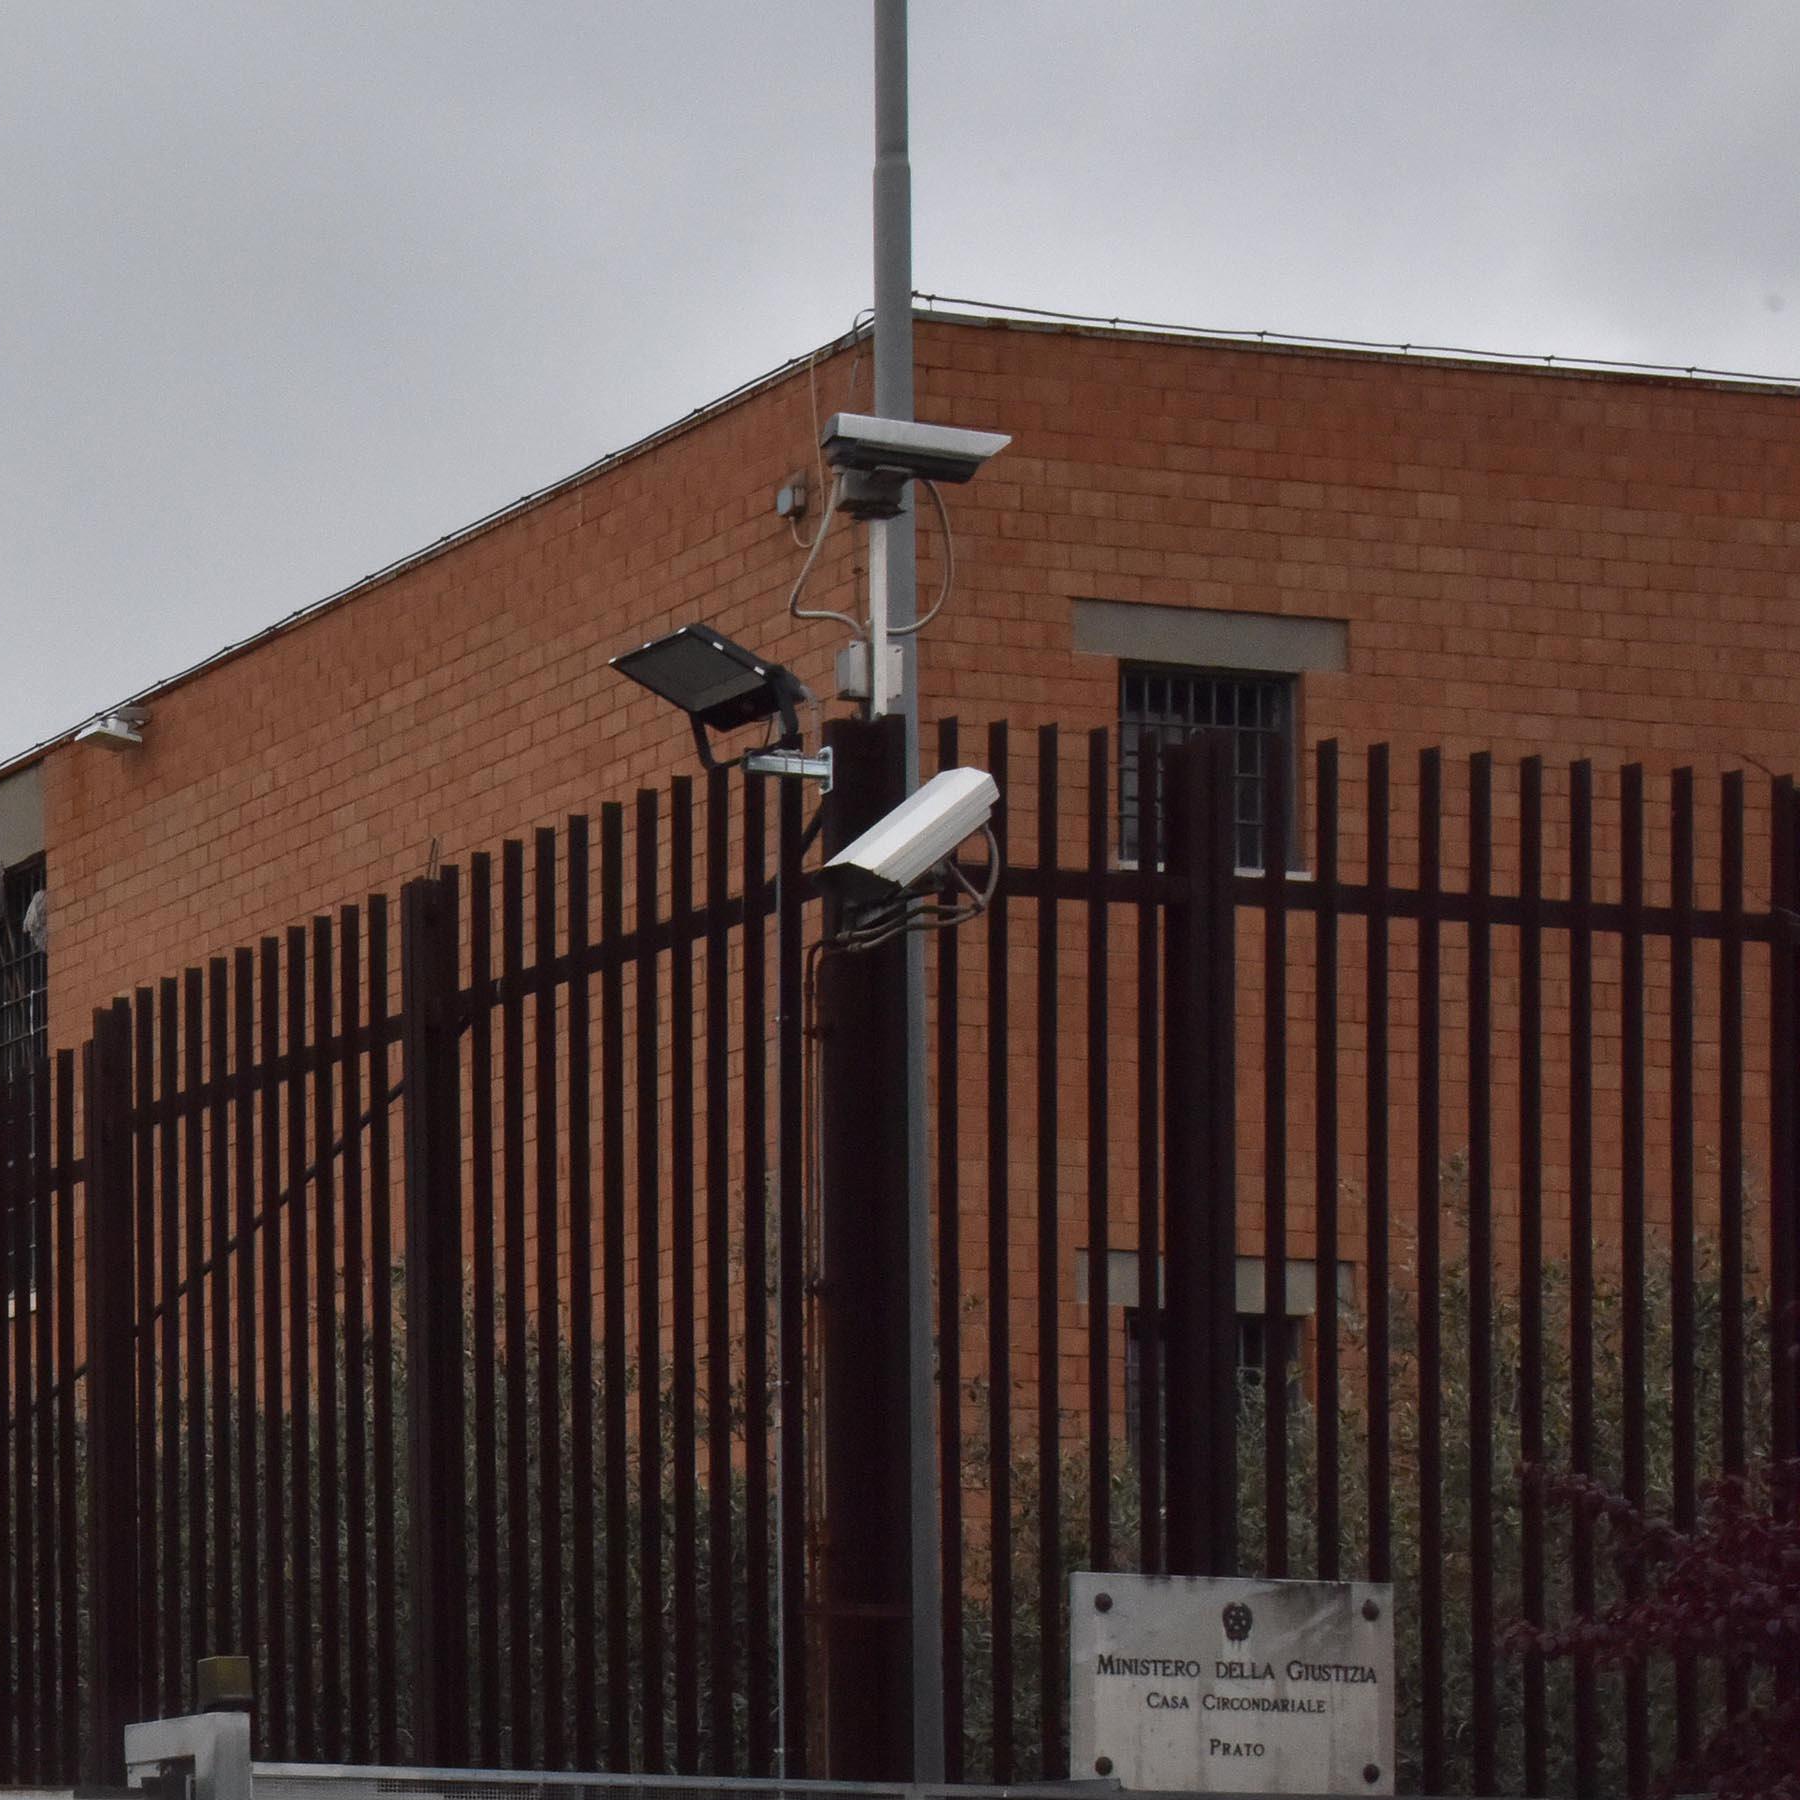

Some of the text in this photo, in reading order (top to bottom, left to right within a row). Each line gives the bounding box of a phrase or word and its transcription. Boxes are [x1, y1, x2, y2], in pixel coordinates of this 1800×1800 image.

[1097, 1654, 1377, 1684] MINISTERO DELLA GIUSTIZIA
[1147, 1692, 1326, 1713] CASA CIRCONDARIALE
[1210, 1738, 1265, 1757] PRATO
